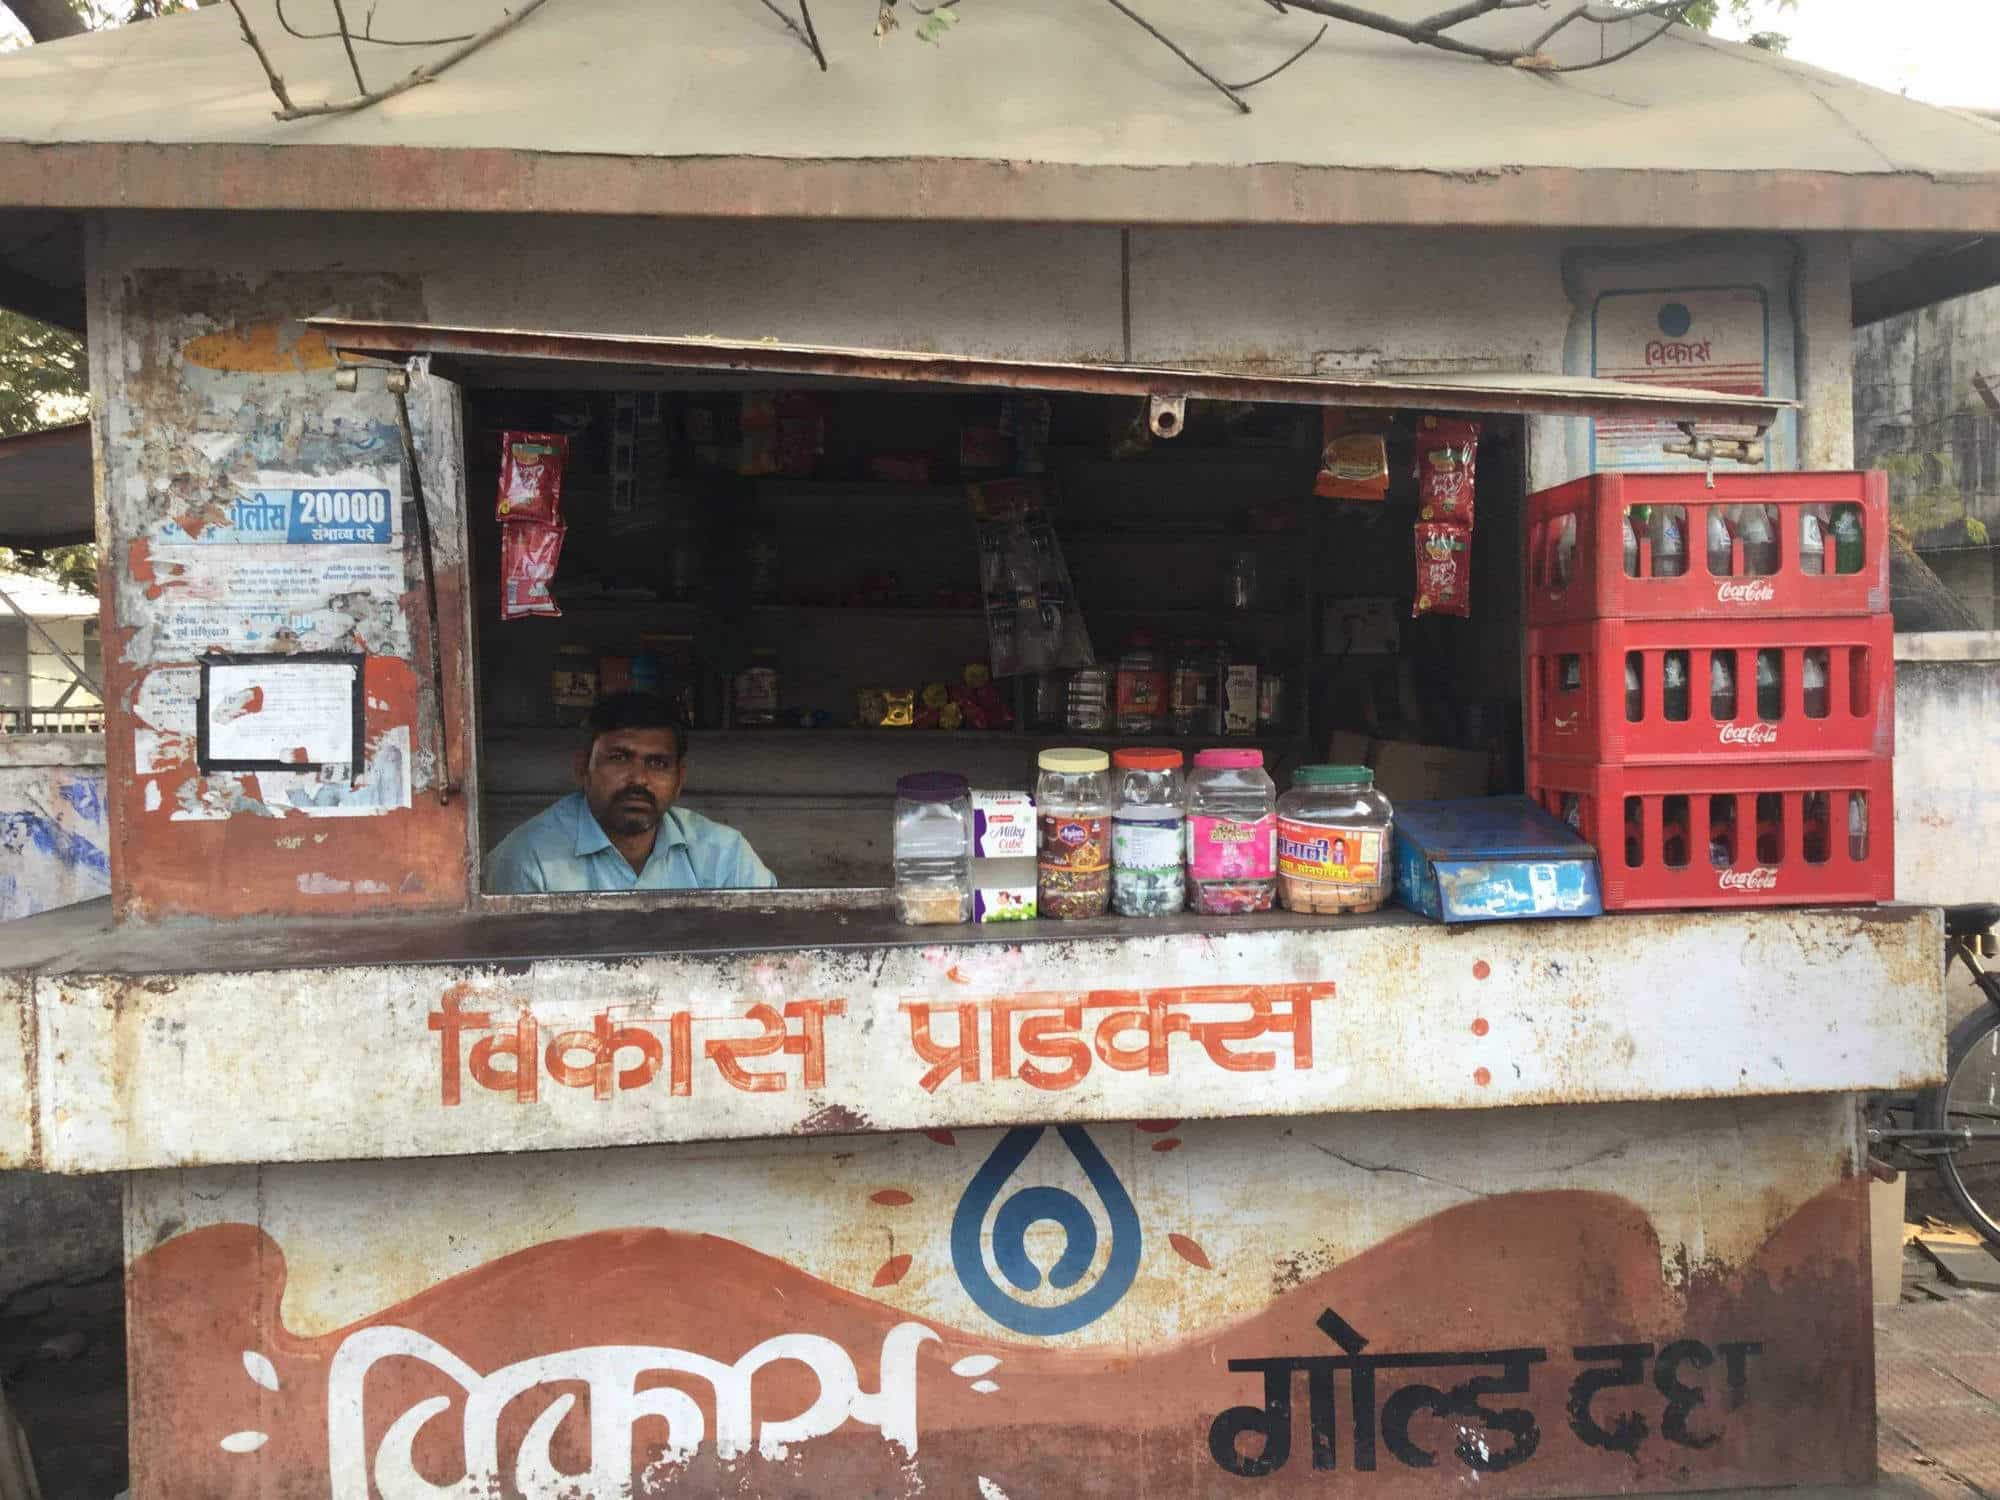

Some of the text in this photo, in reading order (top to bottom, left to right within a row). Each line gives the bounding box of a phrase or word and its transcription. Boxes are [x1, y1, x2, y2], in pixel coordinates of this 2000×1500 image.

[298, 491, 386, 524] 20000
[1717, 579, 1775, 602] Coca-Cola
[1719, 722, 1778, 745] Coca-Cola
[992, 825, 1026, 839] Milky
[1718, 868, 1778, 890] Coca-Cola
[427, 983, 849, 1106] विकास
[1208, 1306, 1548, 1478] गोल्ड
